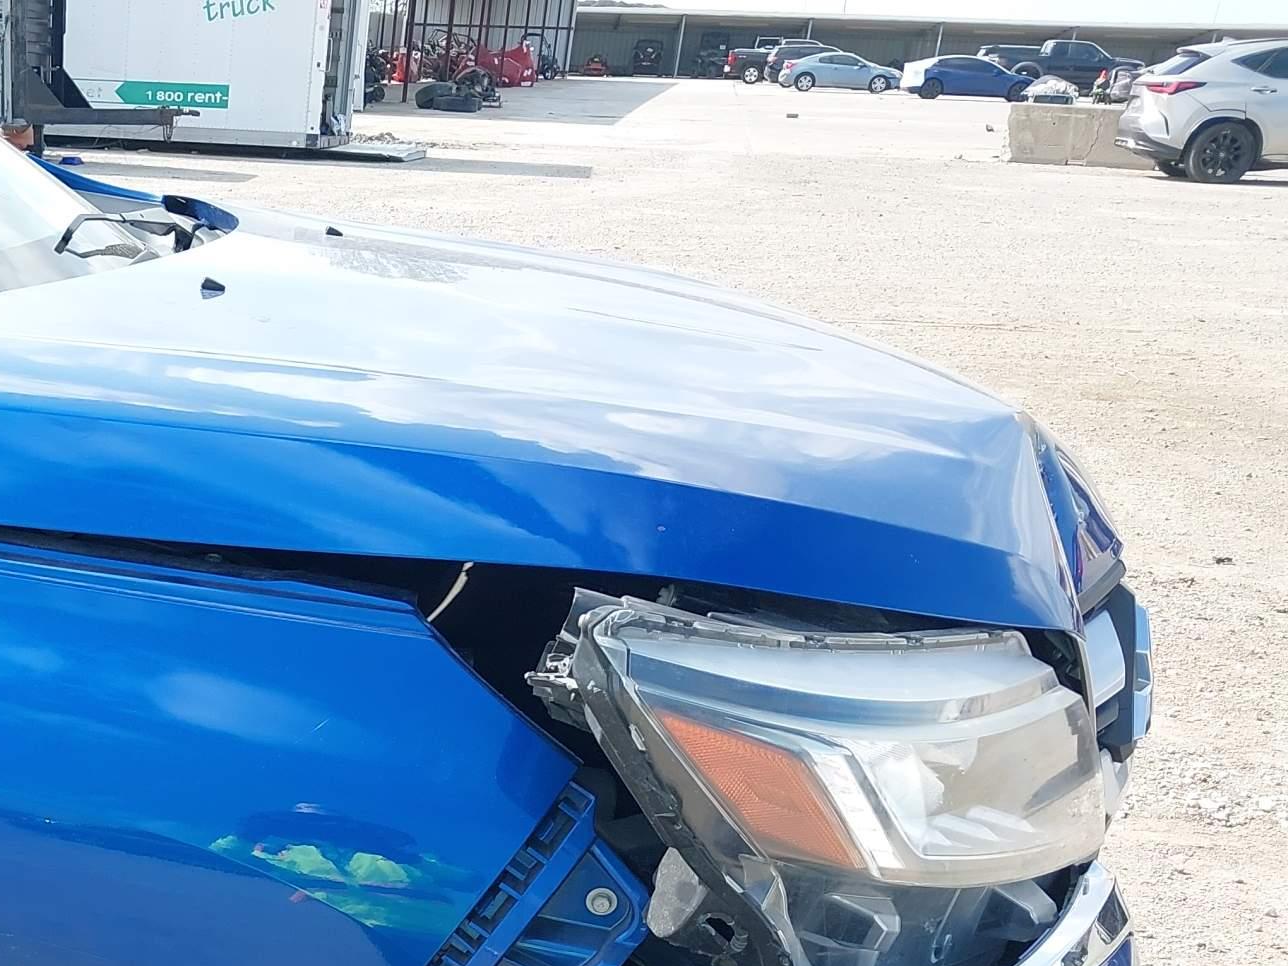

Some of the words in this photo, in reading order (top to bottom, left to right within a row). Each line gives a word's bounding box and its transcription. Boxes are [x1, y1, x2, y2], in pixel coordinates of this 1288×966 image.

[202, 0, 275, 22] truck
[145, 90, 152, 101] 1
[156, 90, 184, 102] 800
[187, 91, 228, 103] rent-
